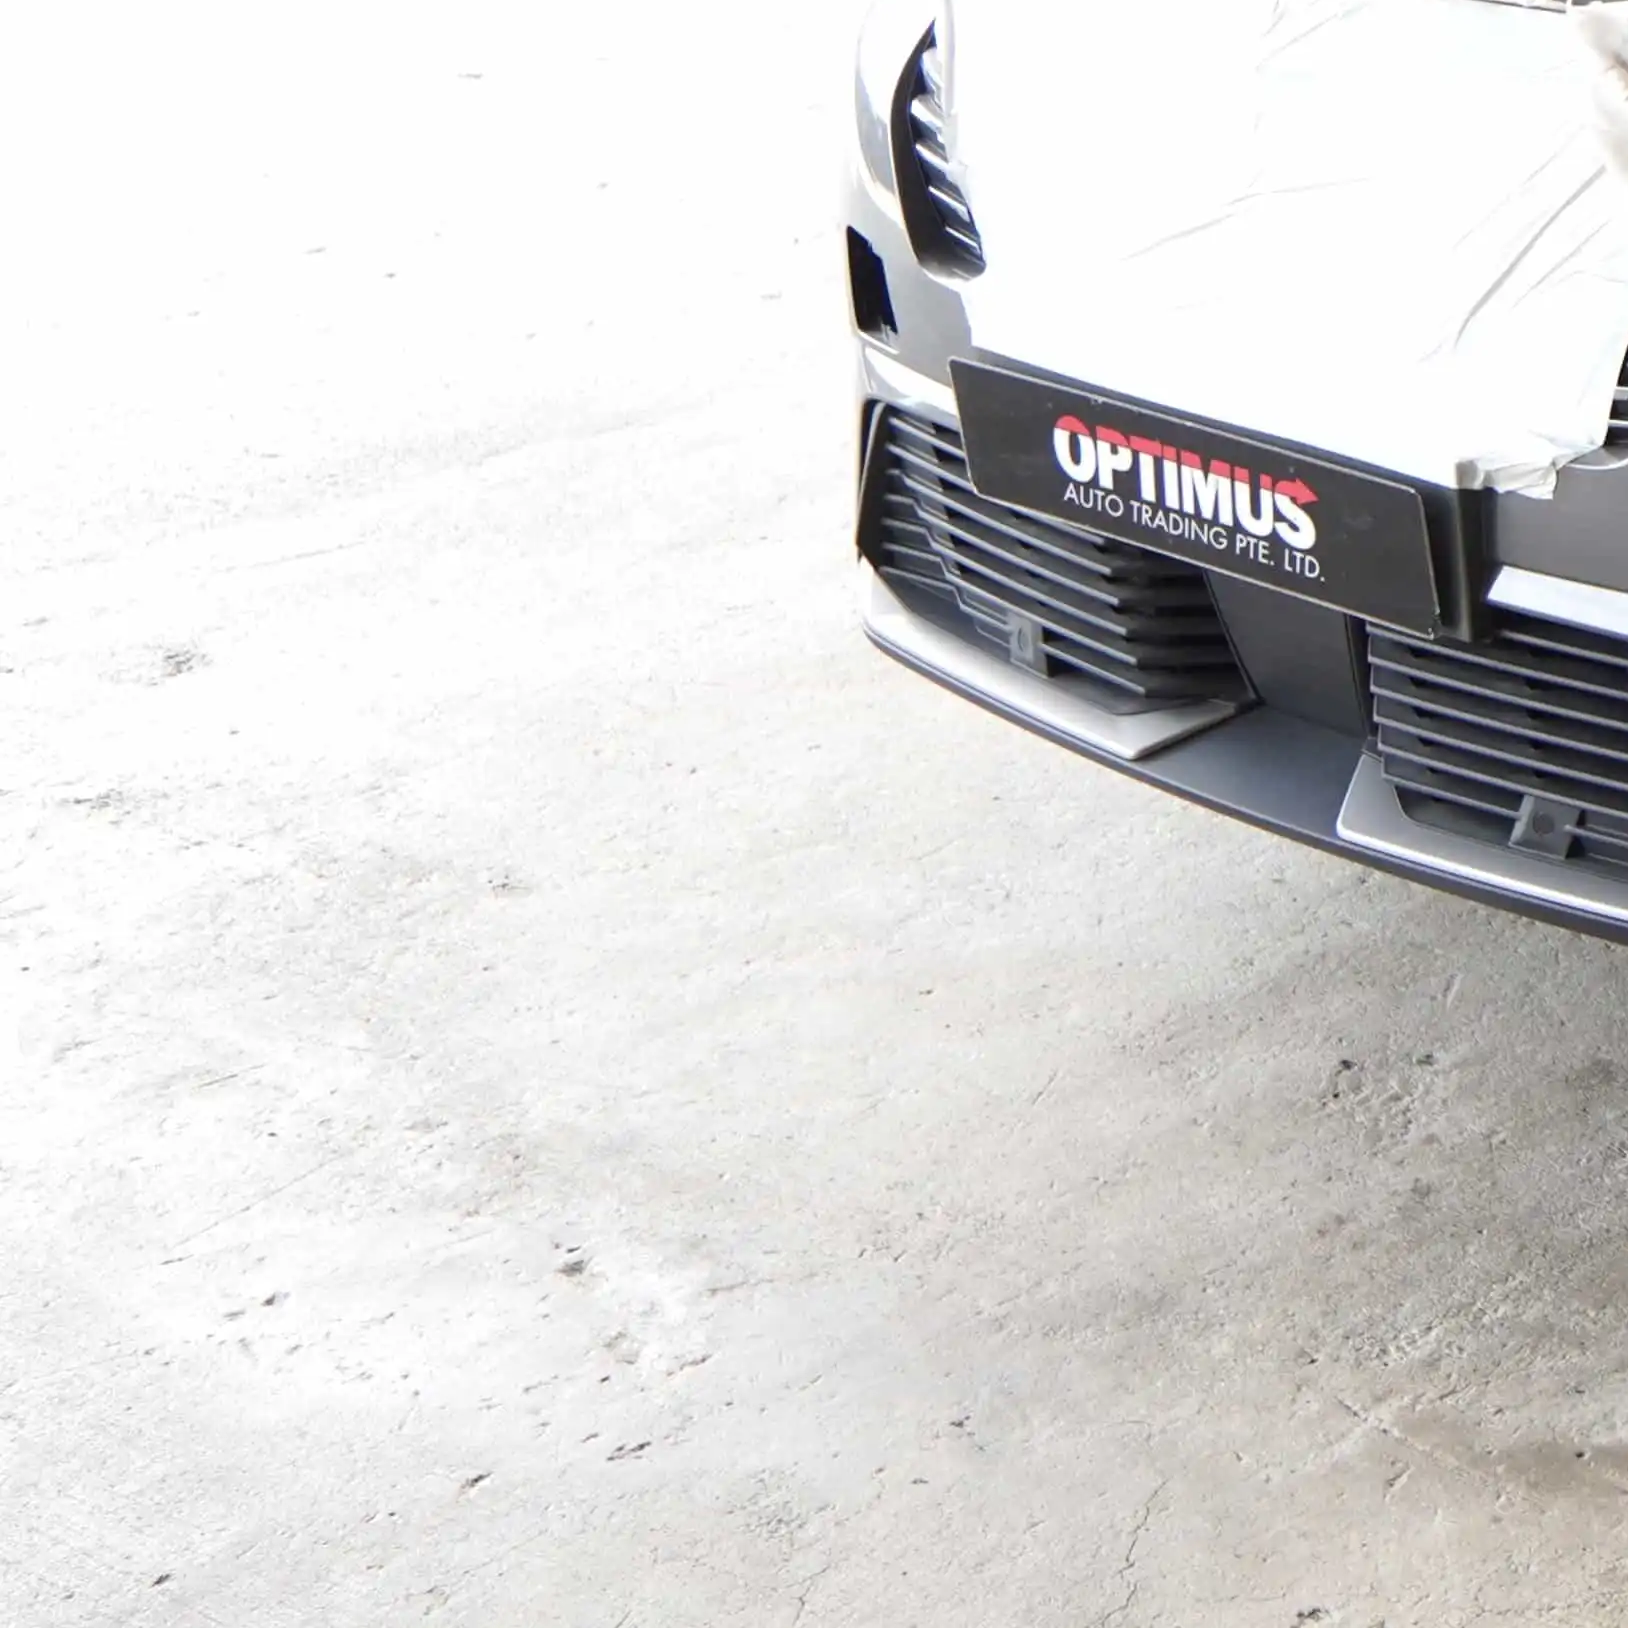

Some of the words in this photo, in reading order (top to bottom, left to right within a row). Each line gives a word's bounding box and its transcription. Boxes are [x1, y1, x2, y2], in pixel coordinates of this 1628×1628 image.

[1053, 414, 1319, 551] OPTIMUS
[1063, 482, 1125, 518] AUTO
[1130, 499, 1229, 550] TRADING
[1235, 533, 1275, 566] PTE.
[1284, 547, 1326, 582] LTD.
